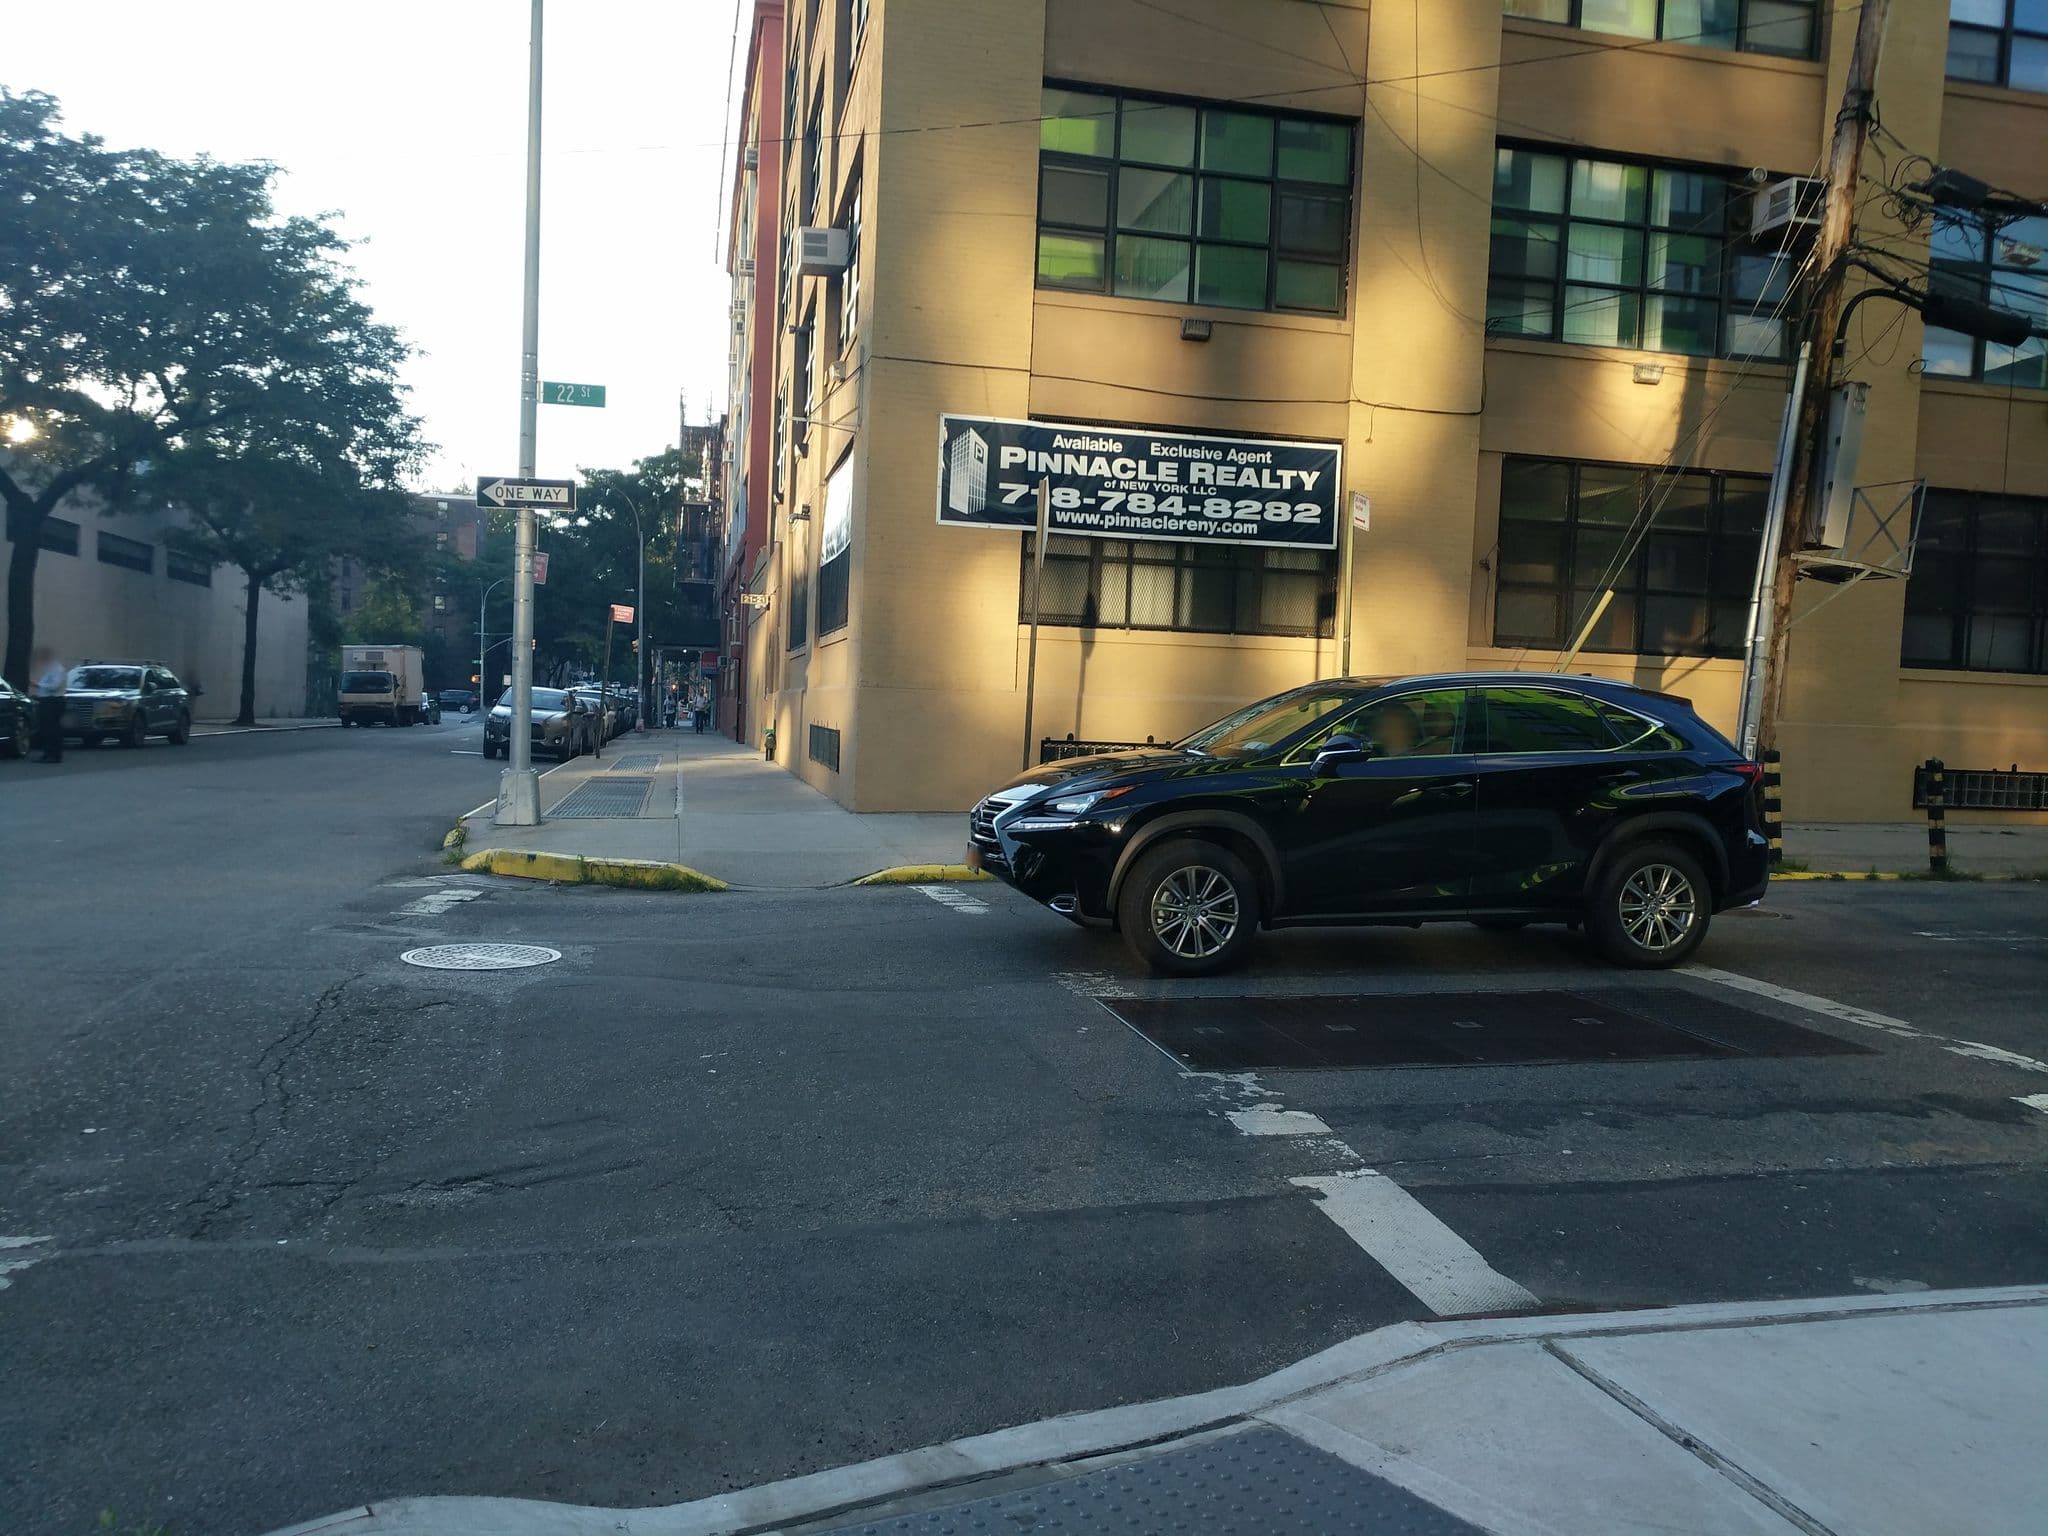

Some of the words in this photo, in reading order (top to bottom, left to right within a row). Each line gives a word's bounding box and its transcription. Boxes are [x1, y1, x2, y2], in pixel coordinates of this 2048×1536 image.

[557, 385, 575, 403] 22
[1052, 434, 1123, 453] Available
[1150, 442, 1223, 461] Exclusive
[1226, 448, 1273, 465] Agent
[1000, 446, 1179, 482] PINNACLE
[1189, 461, 1321, 491] REALTY
[495, 486, 524, 499] ONE
[532, 487, 562, 500] WAY
[1104, 479, 1116, 489] of
[1119, 481, 1149, 491] NEW
[1154, 483, 1189, 495] YORK
[1192, 486, 1217, 496] LLC
[998, 482, 1322, 524] 78-784-8282
[1055, 510, 1258, 535] www.pinnaclereny.com
